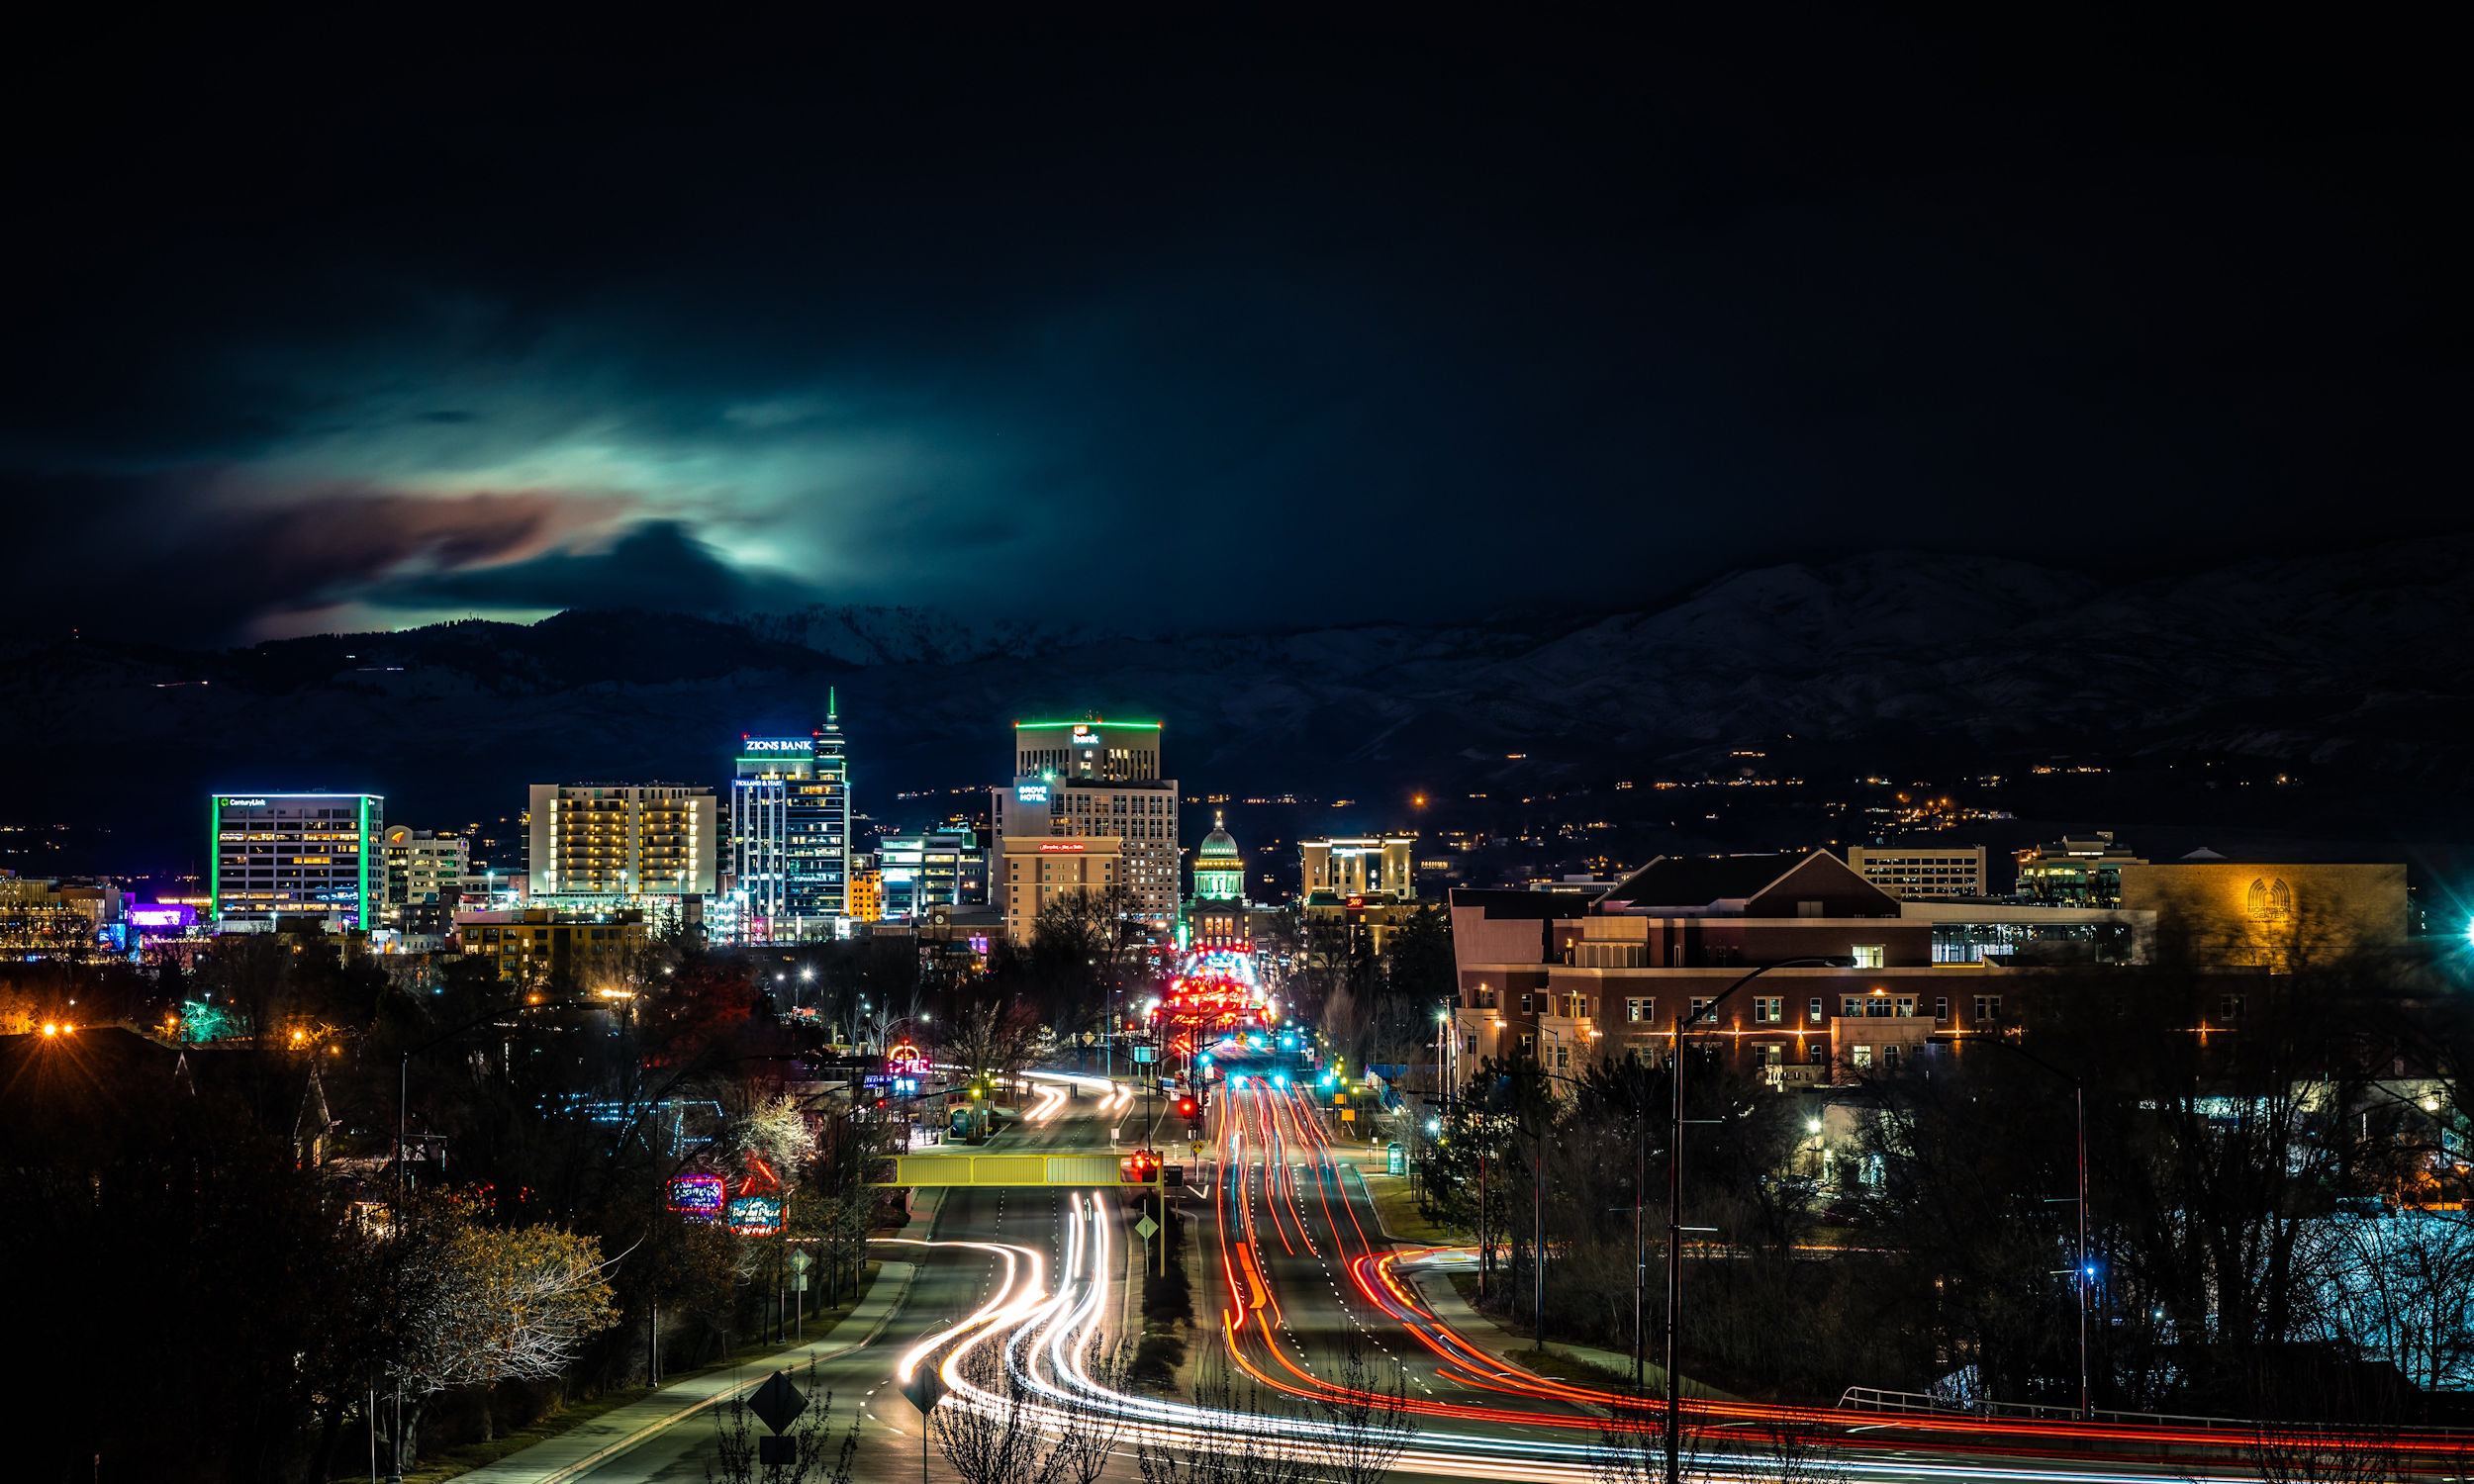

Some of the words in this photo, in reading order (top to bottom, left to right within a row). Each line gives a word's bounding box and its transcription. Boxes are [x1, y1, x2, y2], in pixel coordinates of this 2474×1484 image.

[1073, 734, 1098, 744] bank
[746, 740, 779, 751] ZIONS
[780, 740, 812, 751] BANK
[1018, 786, 1047, 794] GROVE
[229, 798, 266, 807] CenturyLink
